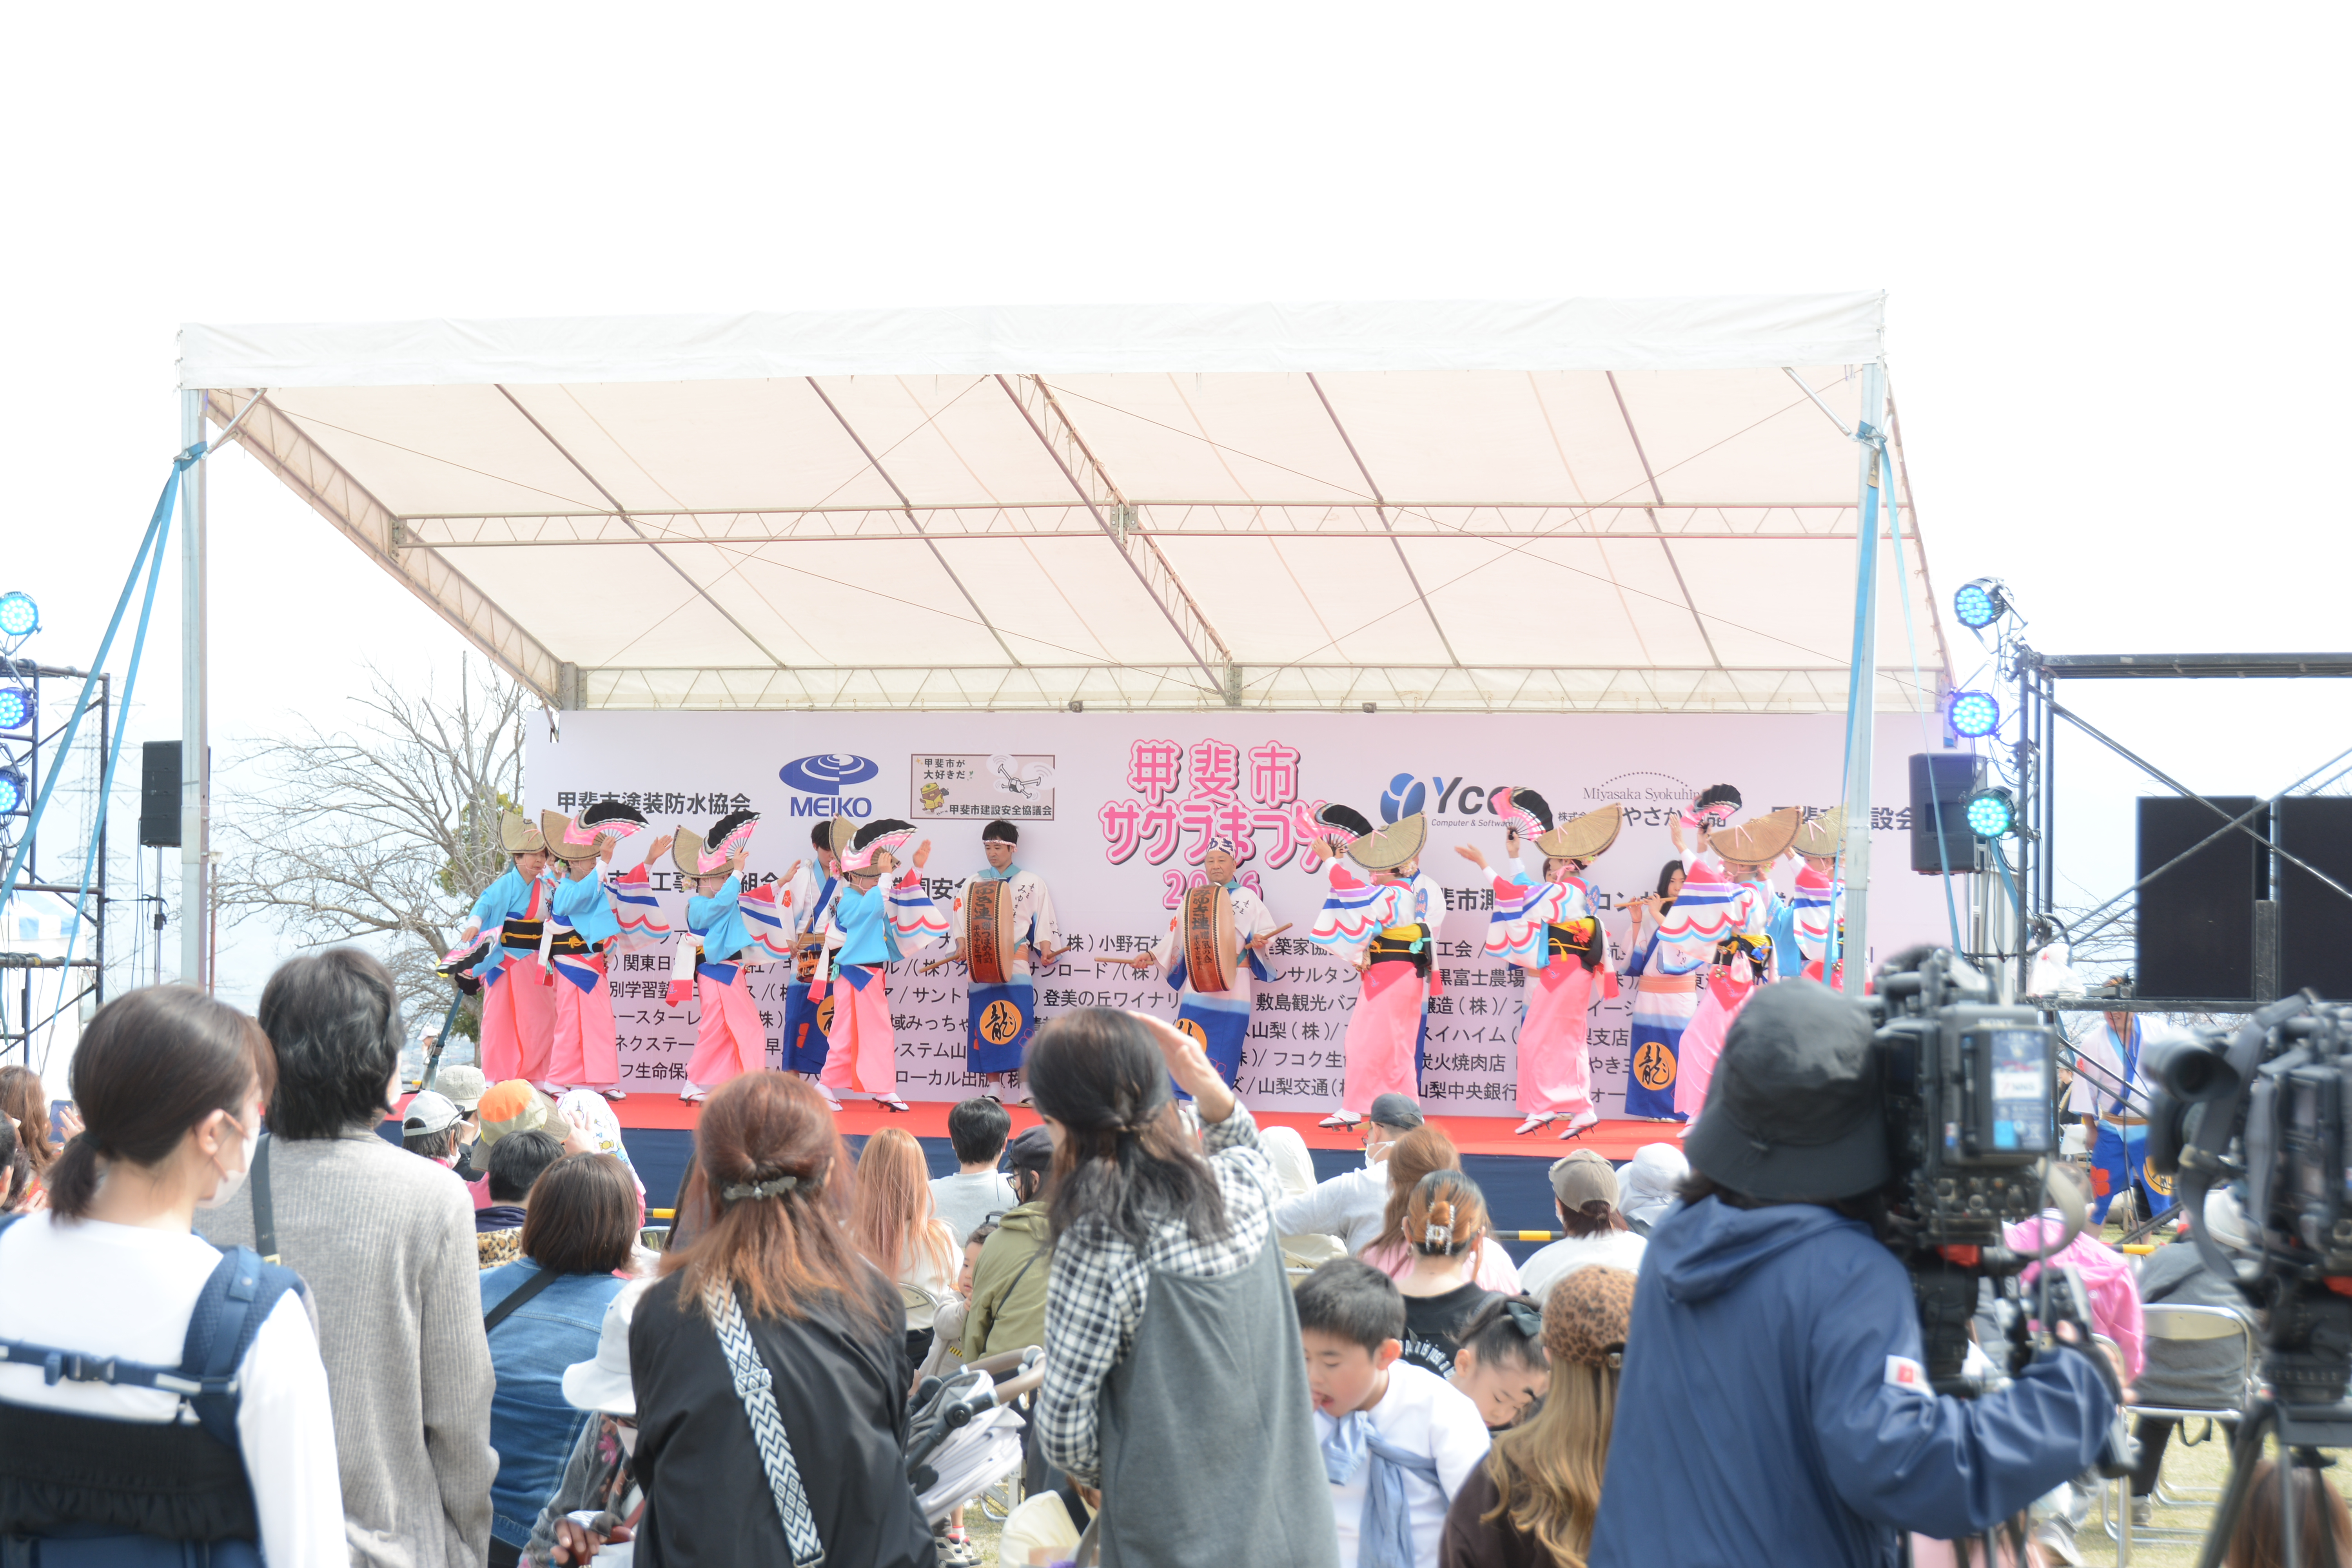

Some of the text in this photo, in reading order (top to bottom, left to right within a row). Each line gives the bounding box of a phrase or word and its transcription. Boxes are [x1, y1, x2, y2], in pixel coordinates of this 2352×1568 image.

[924, 759, 965, 768] 甲斐市が
[924, 769, 965, 780] 大好きだ
[1127, 738, 1301, 808] 甲斐市
[1583, 787, 1700, 802] Miyasaka Syokuhin
[790, 797, 872, 818] MEIKO
[949, 804, 1052, 816] 甲斐市建設安全協議会
[1431, 819, 1469, 828] Computer
[1162, 869, 1263, 910] 26
